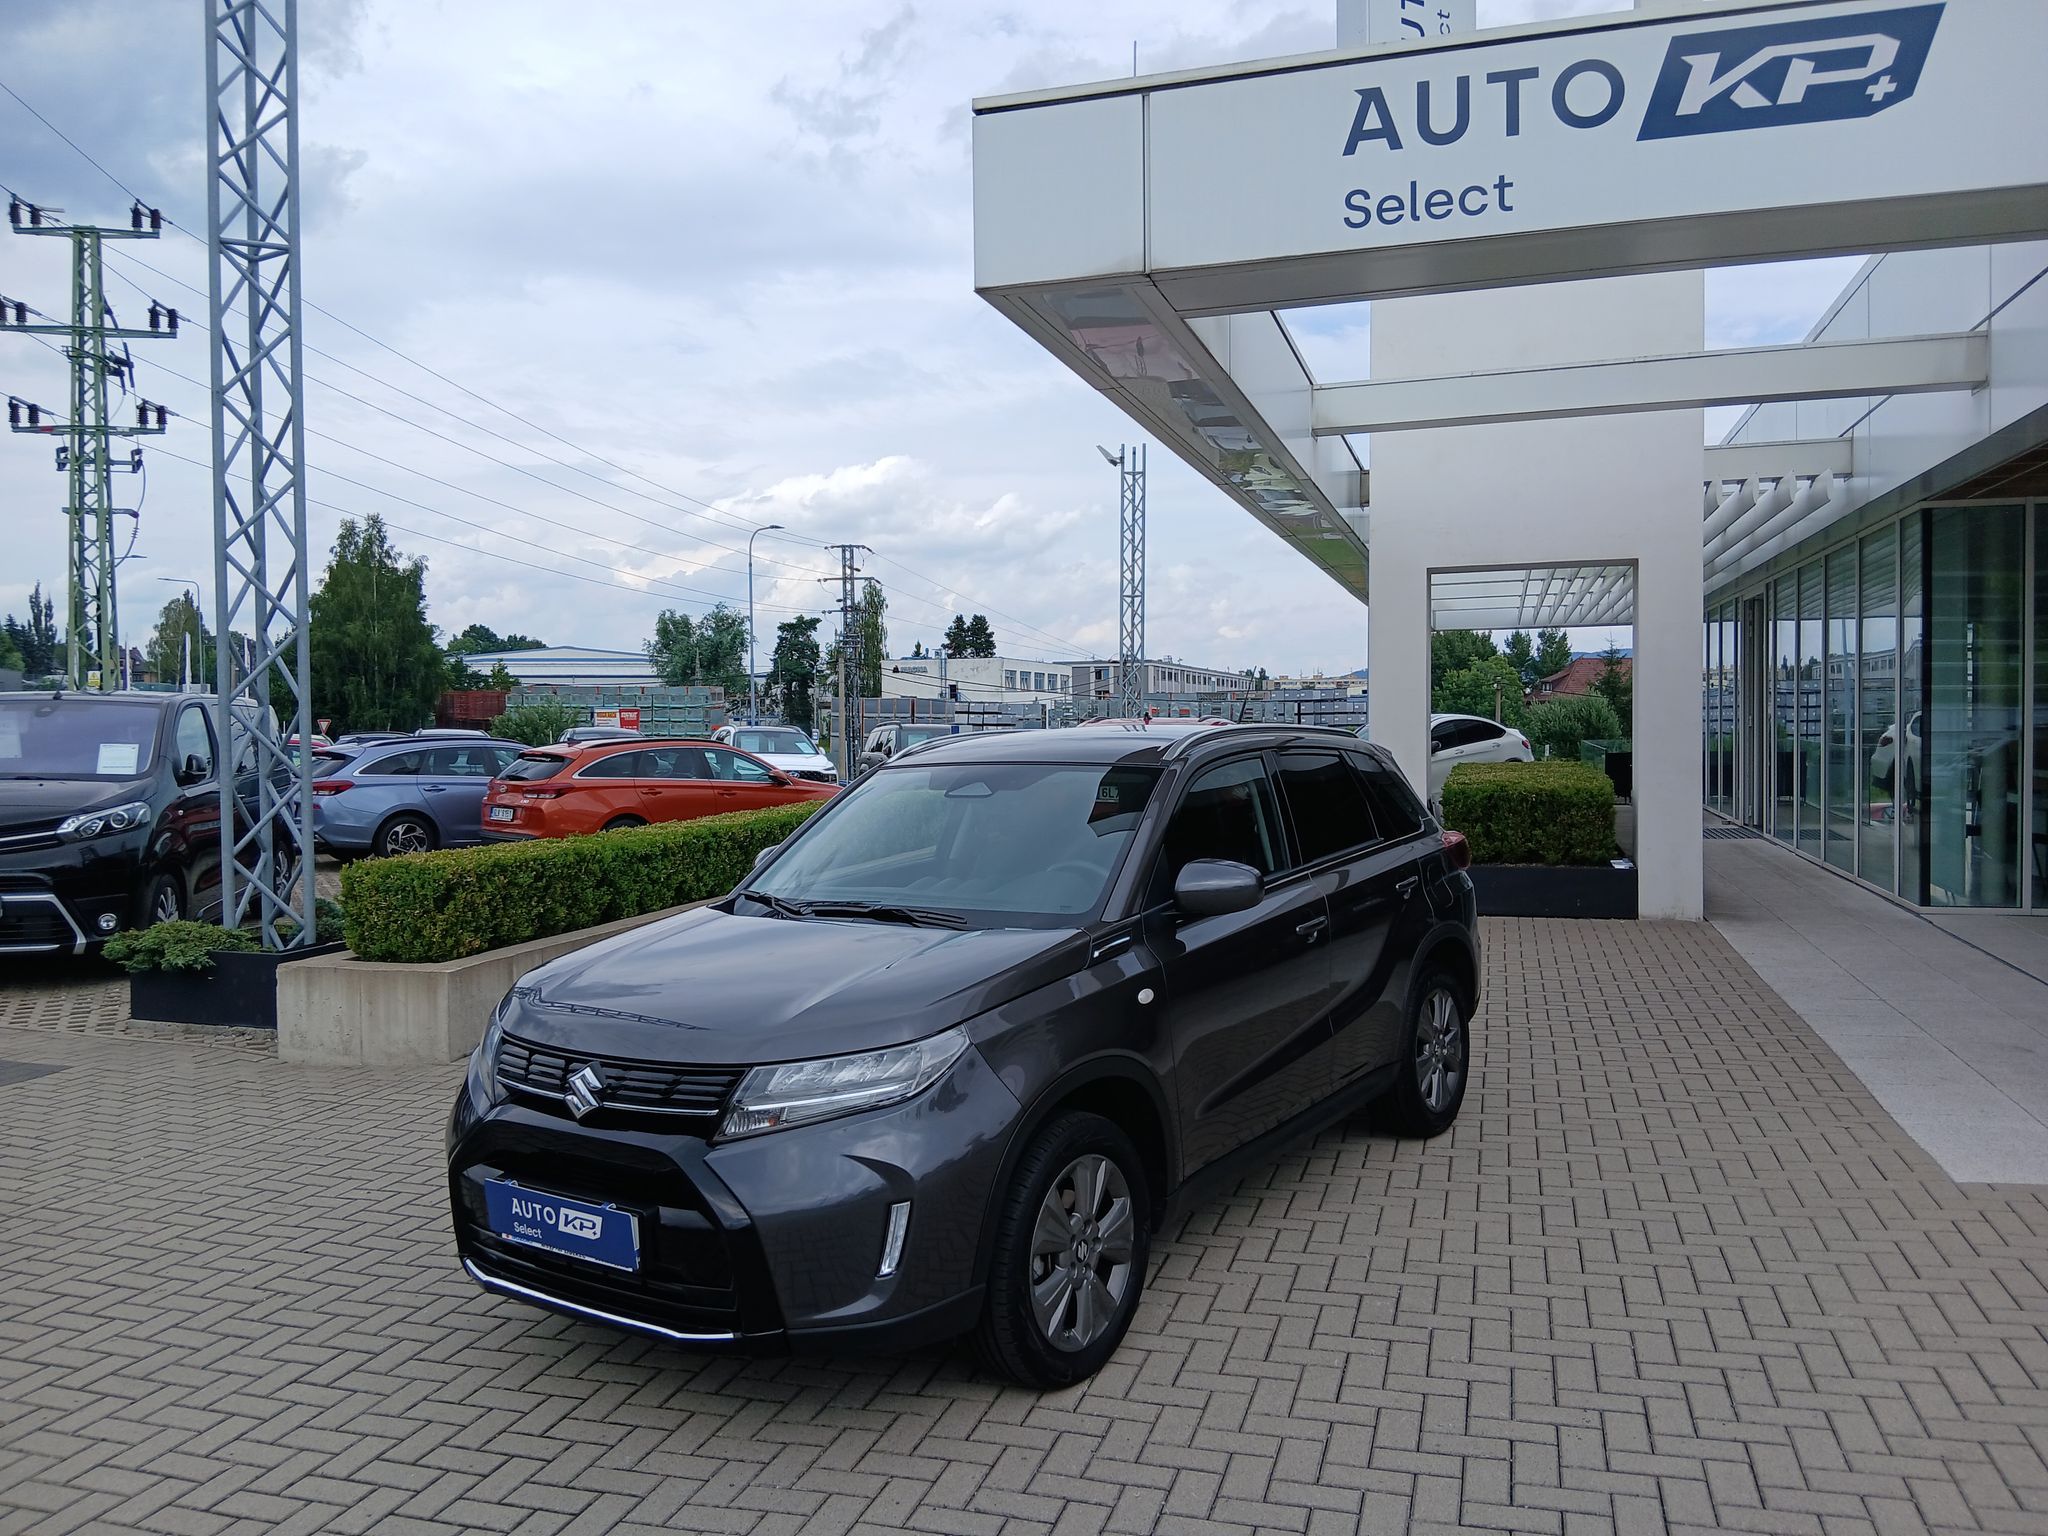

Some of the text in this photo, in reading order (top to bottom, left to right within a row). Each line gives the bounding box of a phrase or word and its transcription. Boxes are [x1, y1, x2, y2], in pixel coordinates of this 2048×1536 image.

[1342, 58, 1626, 156] AUTO
[1343, 174, 1515, 230] Select
[511, 1197, 557, 1225] AUTO
[513, 1221, 543, 1239] Select
